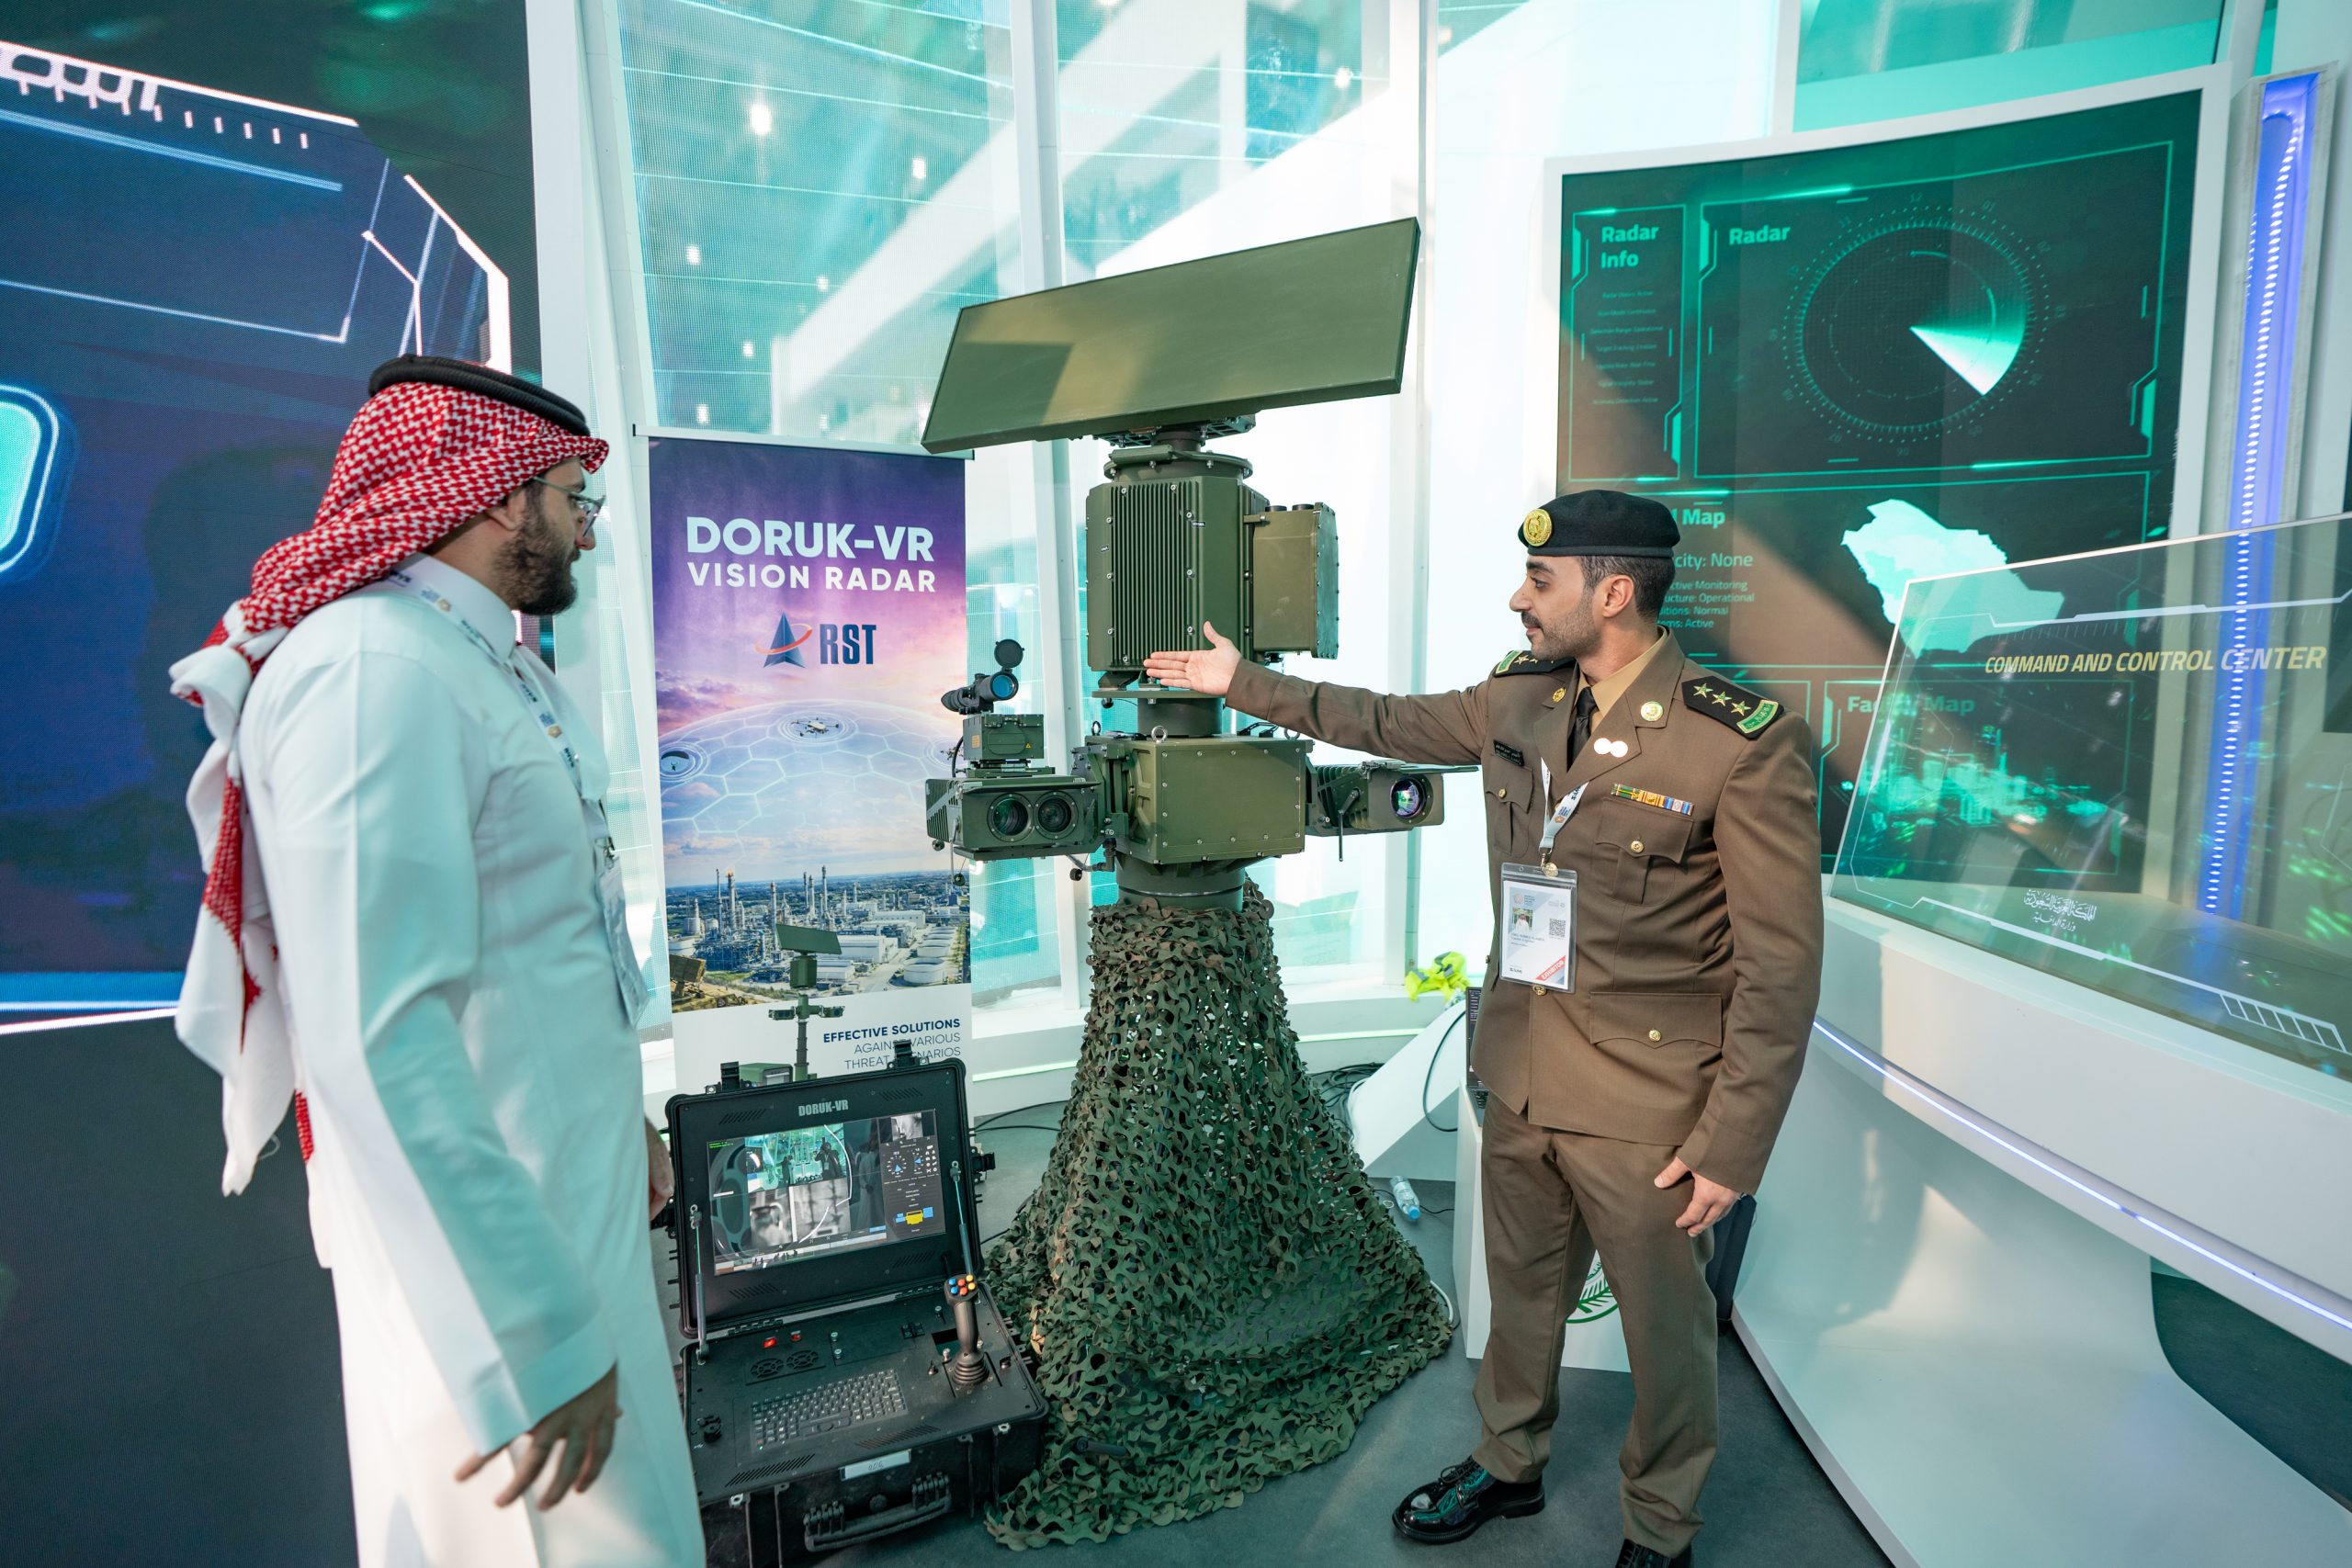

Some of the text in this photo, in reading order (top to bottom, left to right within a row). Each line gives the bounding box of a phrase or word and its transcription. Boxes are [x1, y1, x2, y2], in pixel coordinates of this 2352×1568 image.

[1601, 224, 1659, 243] Radar
[1729, 224, 1791, 245] Radar
[1601, 250, 1639, 268] Info
[1682, 509, 1725, 528] Map
[687, 516, 934, 562] DORUK-VR
[1711, 553, 1753, 568] None
[687, 561, 935, 592] VISION RADAR
[1695, 581, 1747, 592] Monitoring
[1698, 592, 1755, 604] Operational
[1693, 605, 1728, 615] Normal
[1685, 618, 1714, 628] Active
[820, 624, 876, 665] RST
[1985, 646, 2327, 673] COMMAND AND CONTROL CENTER
[1925, 695, 1975, 717] Map
[1541, 960, 1565, 980] EXHIBITOR
[823, 1019, 960, 1043] EFFECTIVE SOLUTIONS
[854, 1032, 961, 1055] AGAIN VARIOUS
[845, 1046, 961, 1070] THREAT NARIOS
[798, 1100, 849, 1116] DORUK-VR
